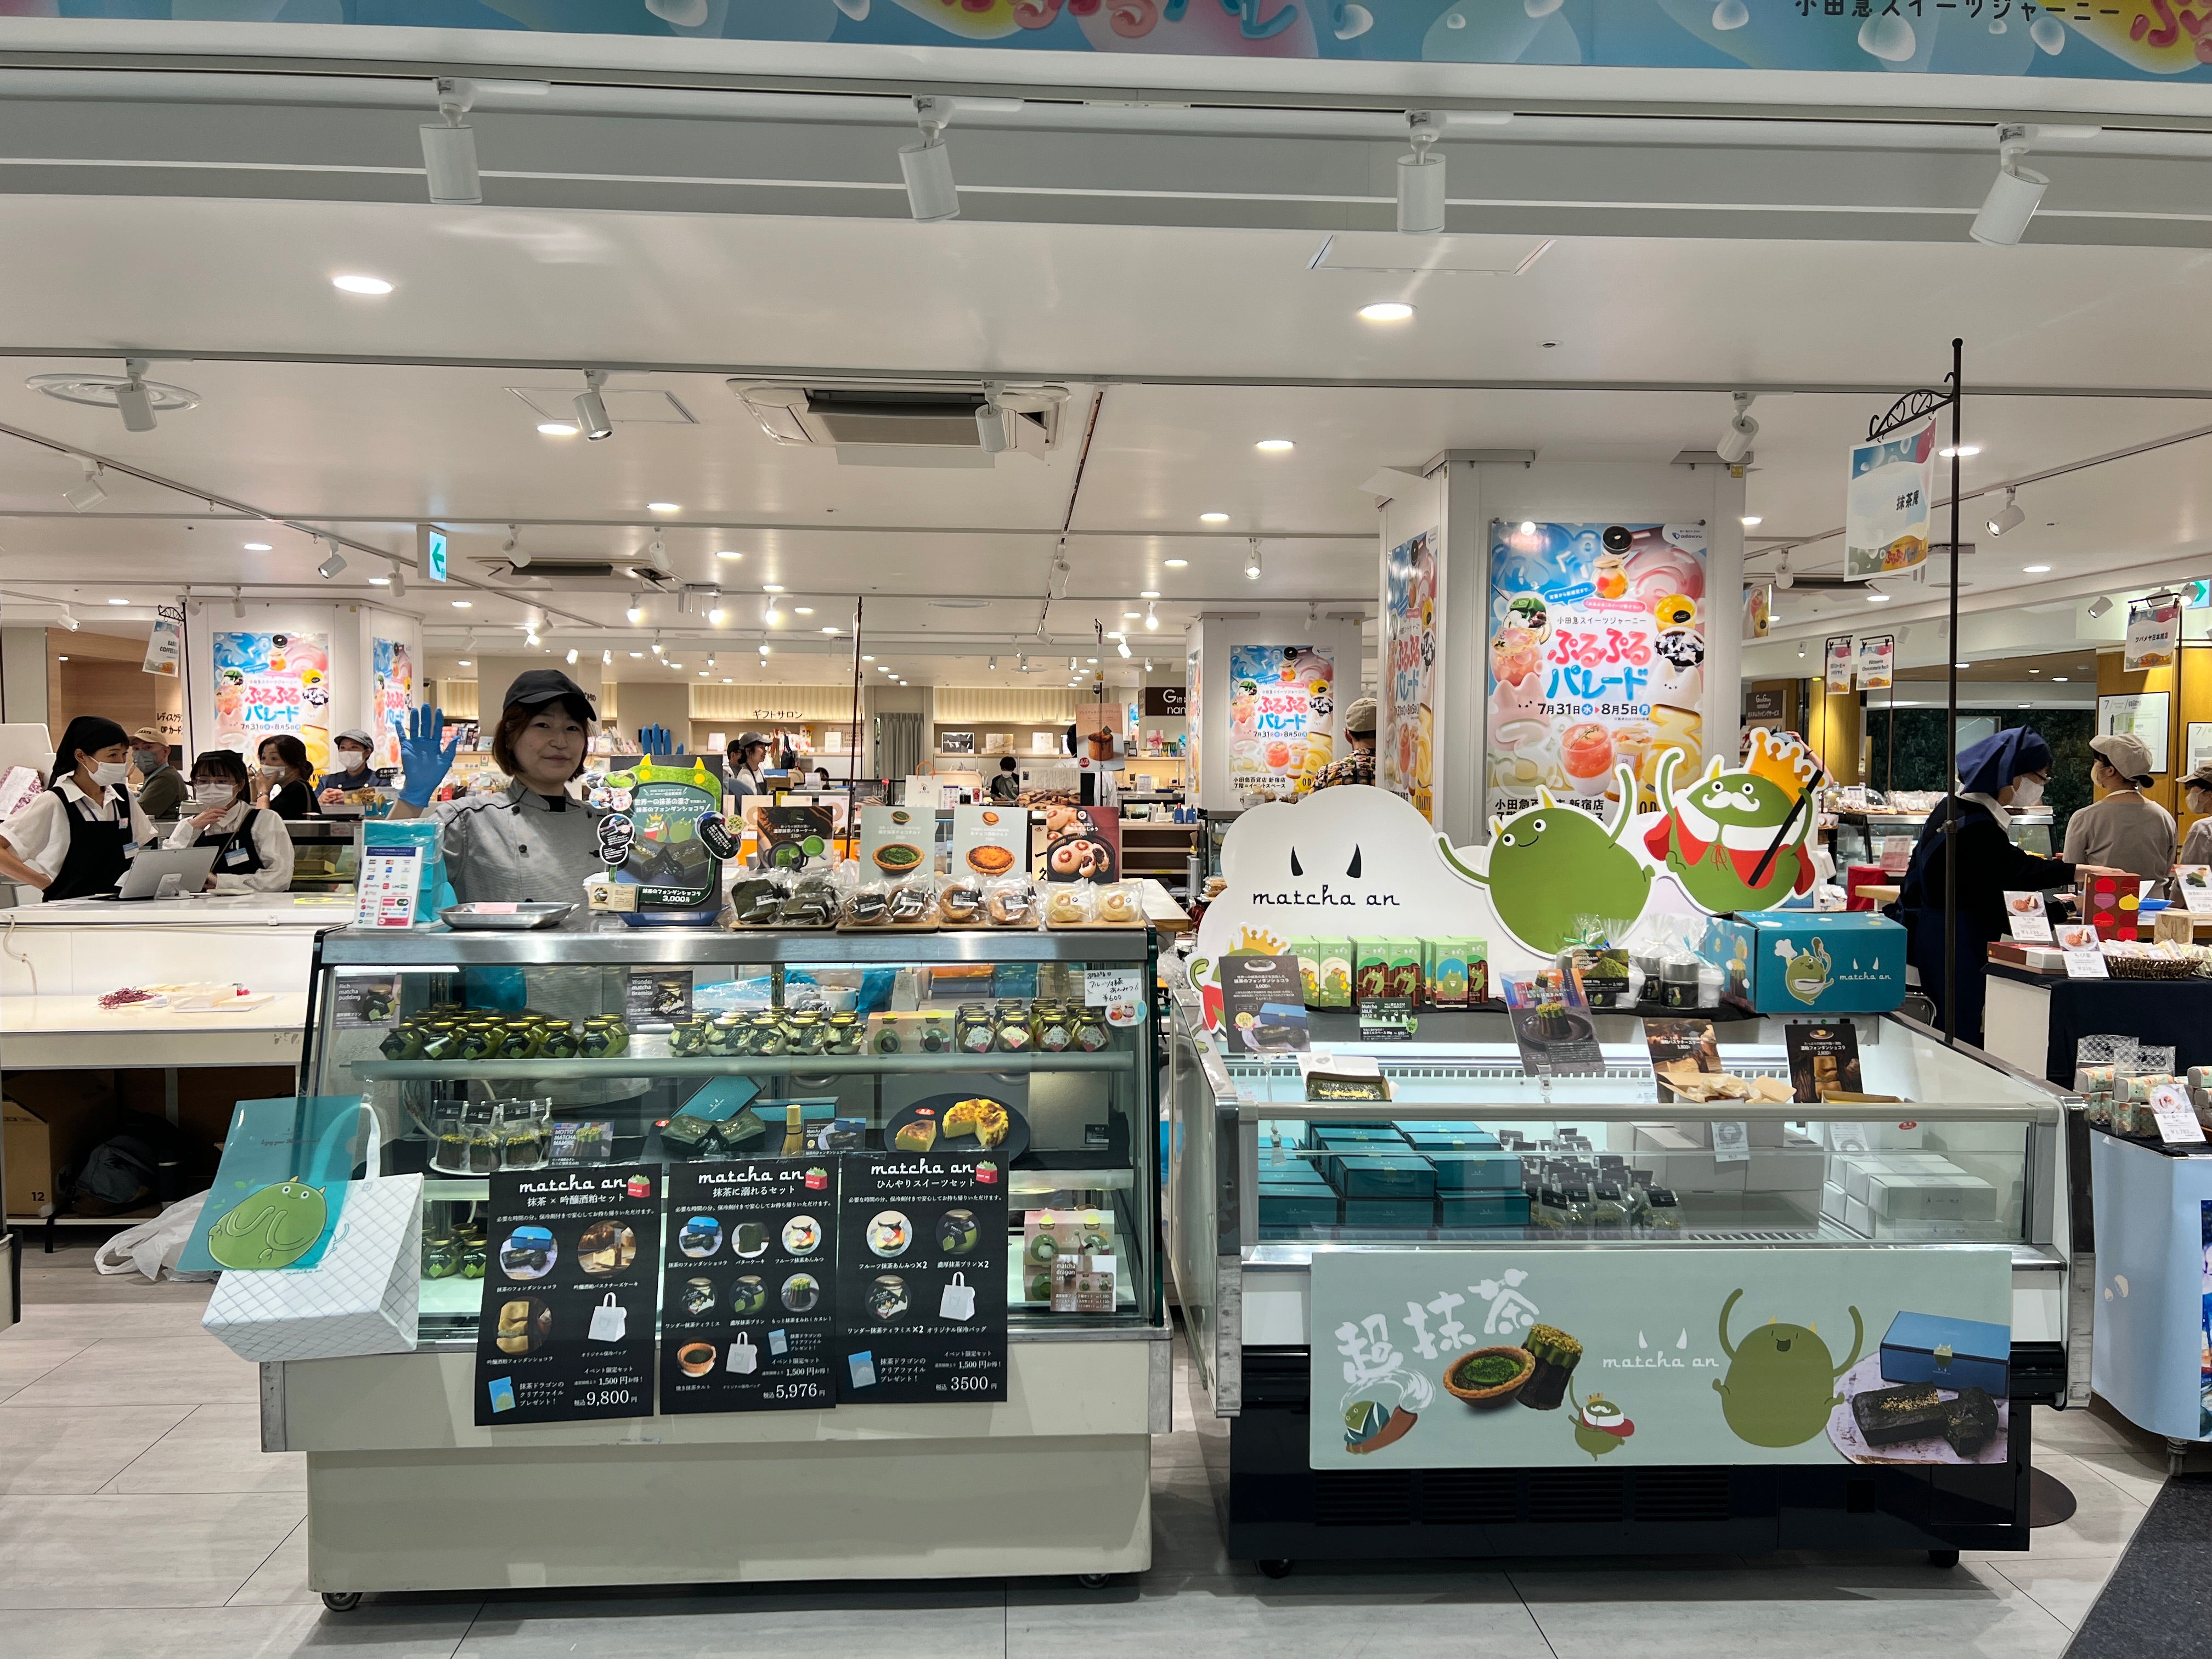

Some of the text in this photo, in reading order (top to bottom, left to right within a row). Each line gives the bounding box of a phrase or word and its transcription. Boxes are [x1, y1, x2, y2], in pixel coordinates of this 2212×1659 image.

[1547, 628, 1651, 667] ぷるぷる
[1546, 664, 1649, 701] パレード
[245, 686, 301, 706] ぷるぷる
[1258, 695, 1308, 714] ぷるぷる
[157, 713, 183, 722] レディスクラ
[245, 704, 300, 723] パレード
[752, 709, 803, 720] ギフトサロン
[1257, 713, 1307, 730] パレード
[1253, 884, 1400, 906] matcha an
[871, 1158, 975, 1175] matcha an
[698, 1166, 804, 1184] matcha an
[520, 1174, 627, 1193] matcha an
[713, 1185, 795, 1198] 抹茶に溺れるセット
[877, 1179, 975, 1189] ひんやりスイーツセット
[31, 1192, 45, 1201] 12
[668, 1260, 727, 1268] 抹茶のフォンダンショコラ
[496, 1284, 557, 1293] 抹茶のフォンダンショコラ
[1335, 1268, 1540, 1384] 超抹茶
[880, 1358, 926, 1366] 抹茶ドラゴンの
[1602, 1351, 1719, 1368] matcha an
[584, 1365, 633, 1374] イベント限定セット
[520, 1380, 564, 1390] 抹茶ドラゴンの
[776, 1383, 817, 1400] 5,976
[951, 1376, 988, 1391] 3500
[520, 1390, 564, 1398] クリアファイル
[586, 1390, 629, 1406] 9,800
